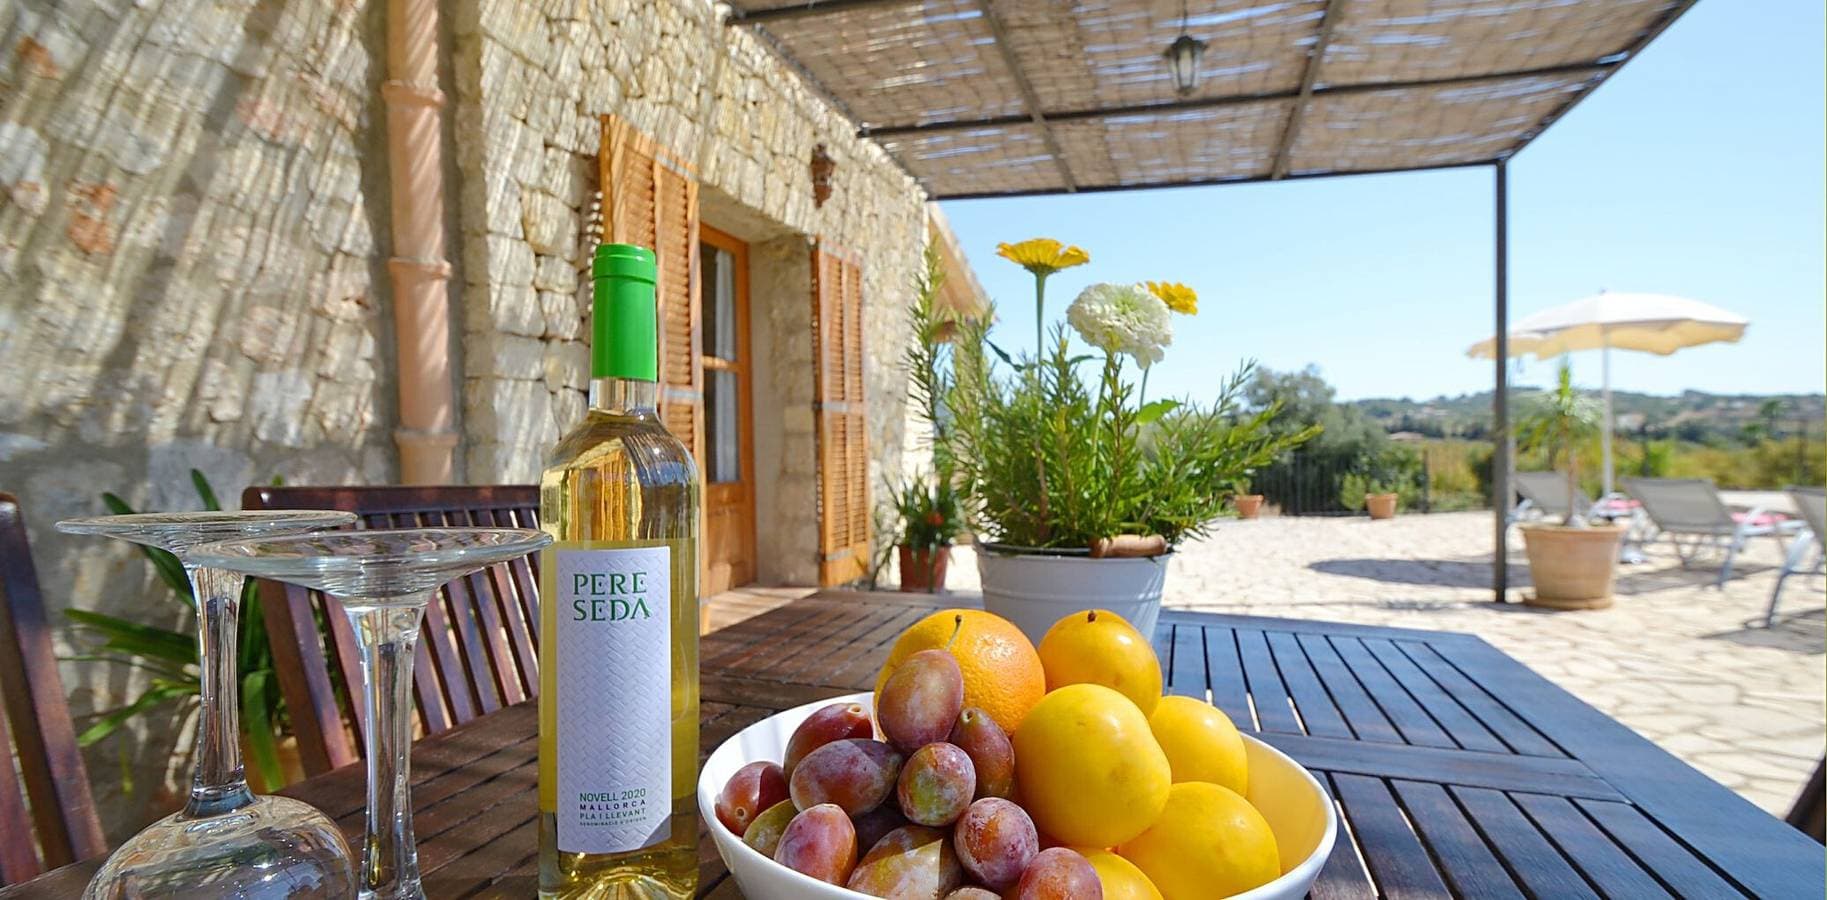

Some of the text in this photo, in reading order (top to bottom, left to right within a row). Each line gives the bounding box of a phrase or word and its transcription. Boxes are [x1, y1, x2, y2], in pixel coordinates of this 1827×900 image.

[573, 572, 647, 595] PERE
[573, 598, 650, 621] SEDA
[579, 788, 646, 802] NOVELL 2020
[579, 800, 646, 811] MALLORCA
[579, 812, 596, 820] PLA
[605, 808, 646, 820] LLEVANT
